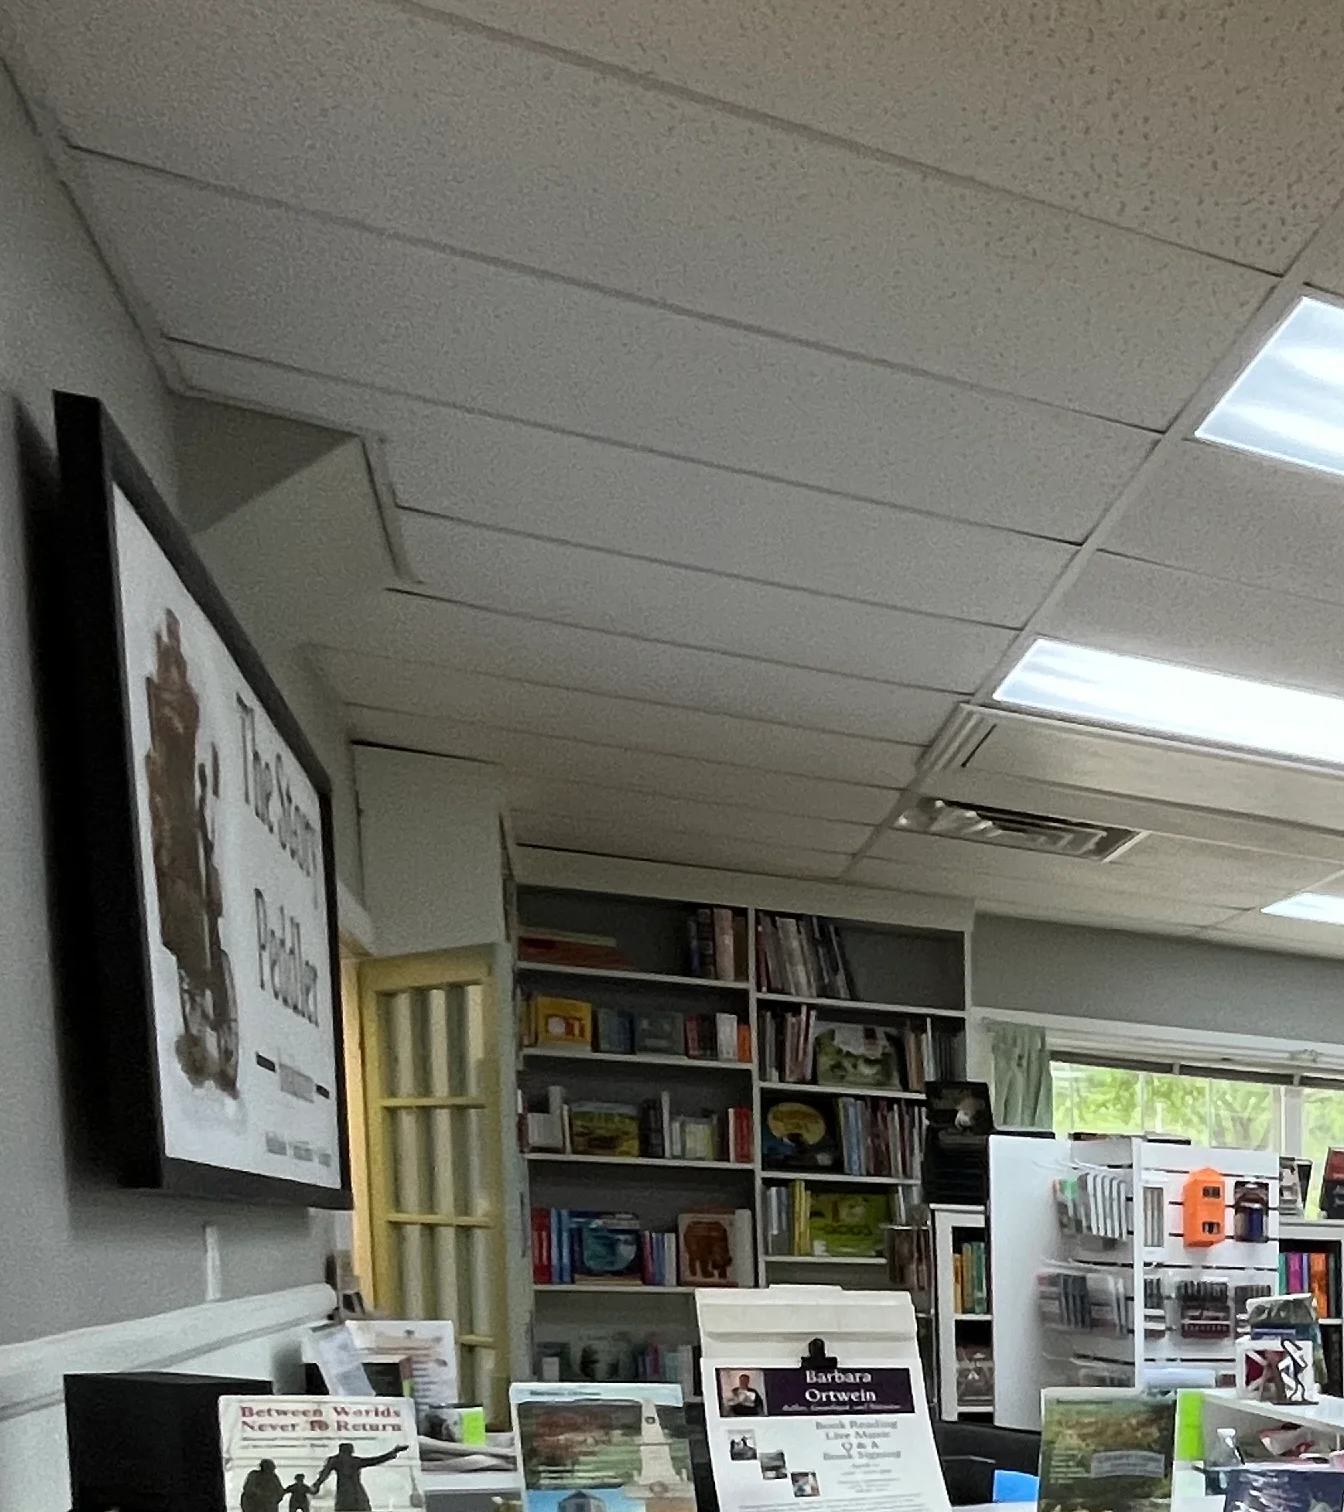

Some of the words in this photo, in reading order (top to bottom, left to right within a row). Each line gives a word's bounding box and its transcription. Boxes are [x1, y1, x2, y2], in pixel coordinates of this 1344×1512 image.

[236, 691, 274, 835] The
[275, 751, 320, 911] Story
[254, 887, 320, 1029] Peddler
[806, 1369, 873, 1384] Barbara
[804, 1388, 877, 1402] Ortwein
[240, 1405, 323, 1418] Between
[332, 1405, 401, 1418] Worlds
[240, 1419, 299, 1432] Never
[336, 1418, 402, 1432] Return
